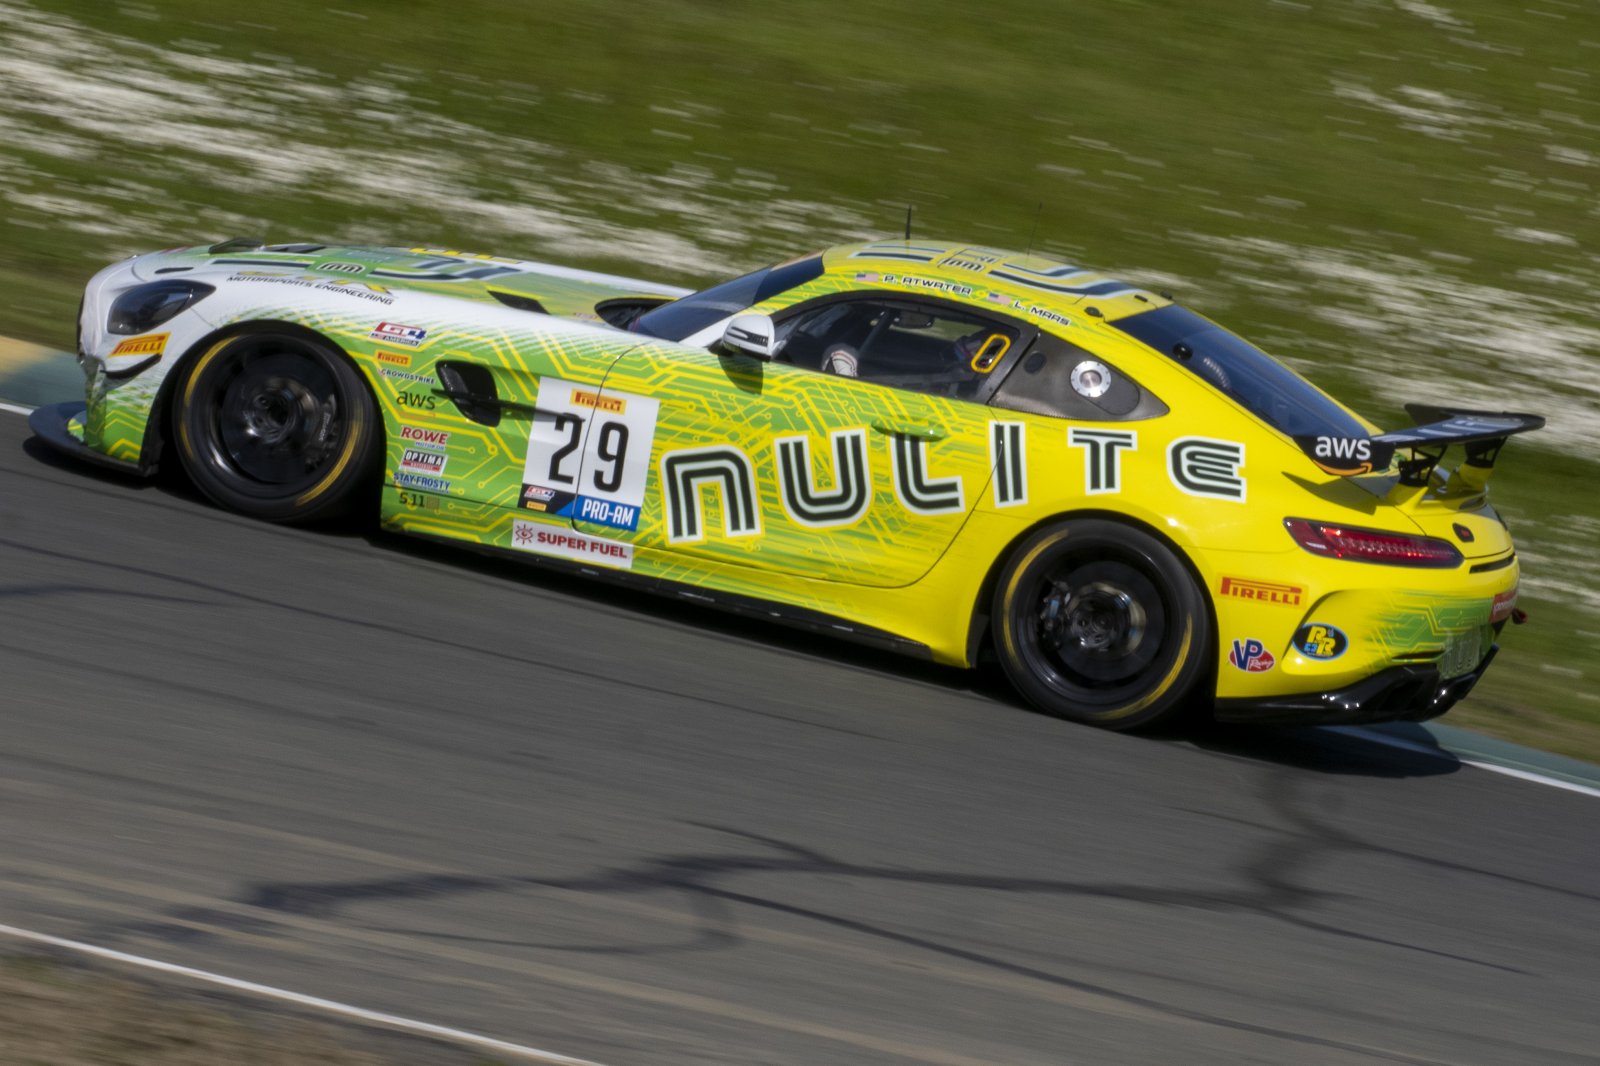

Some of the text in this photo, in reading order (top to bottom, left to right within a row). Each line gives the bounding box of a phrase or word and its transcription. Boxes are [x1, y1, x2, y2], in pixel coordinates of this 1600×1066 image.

[314, 284, 394, 306] ENGINEERING
[902, 276, 972, 295] ATWATER
[113, 335, 166, 355] PIRELLI
[377, 351, 409, 365] PIRELLI
[381, 368, 435, 384] CROWDSTRIKE
[396, 391, 436, 410] aws
[575, 391, 622, 412] PIRELLI
[401, 426, 448, 446] ROWE
[405, 451, 443, 466] OPTIMA
[548, 412, 629, 492] 29
[1315, 435, 1371, 461] aws
[581, 498, 634, 527] PRO-AM
[537, 531, 628, 559] SUPER FUEL
[1221, 577, 1302, 606] PIRELLI
[1232, 638, 1263, 672] VP
